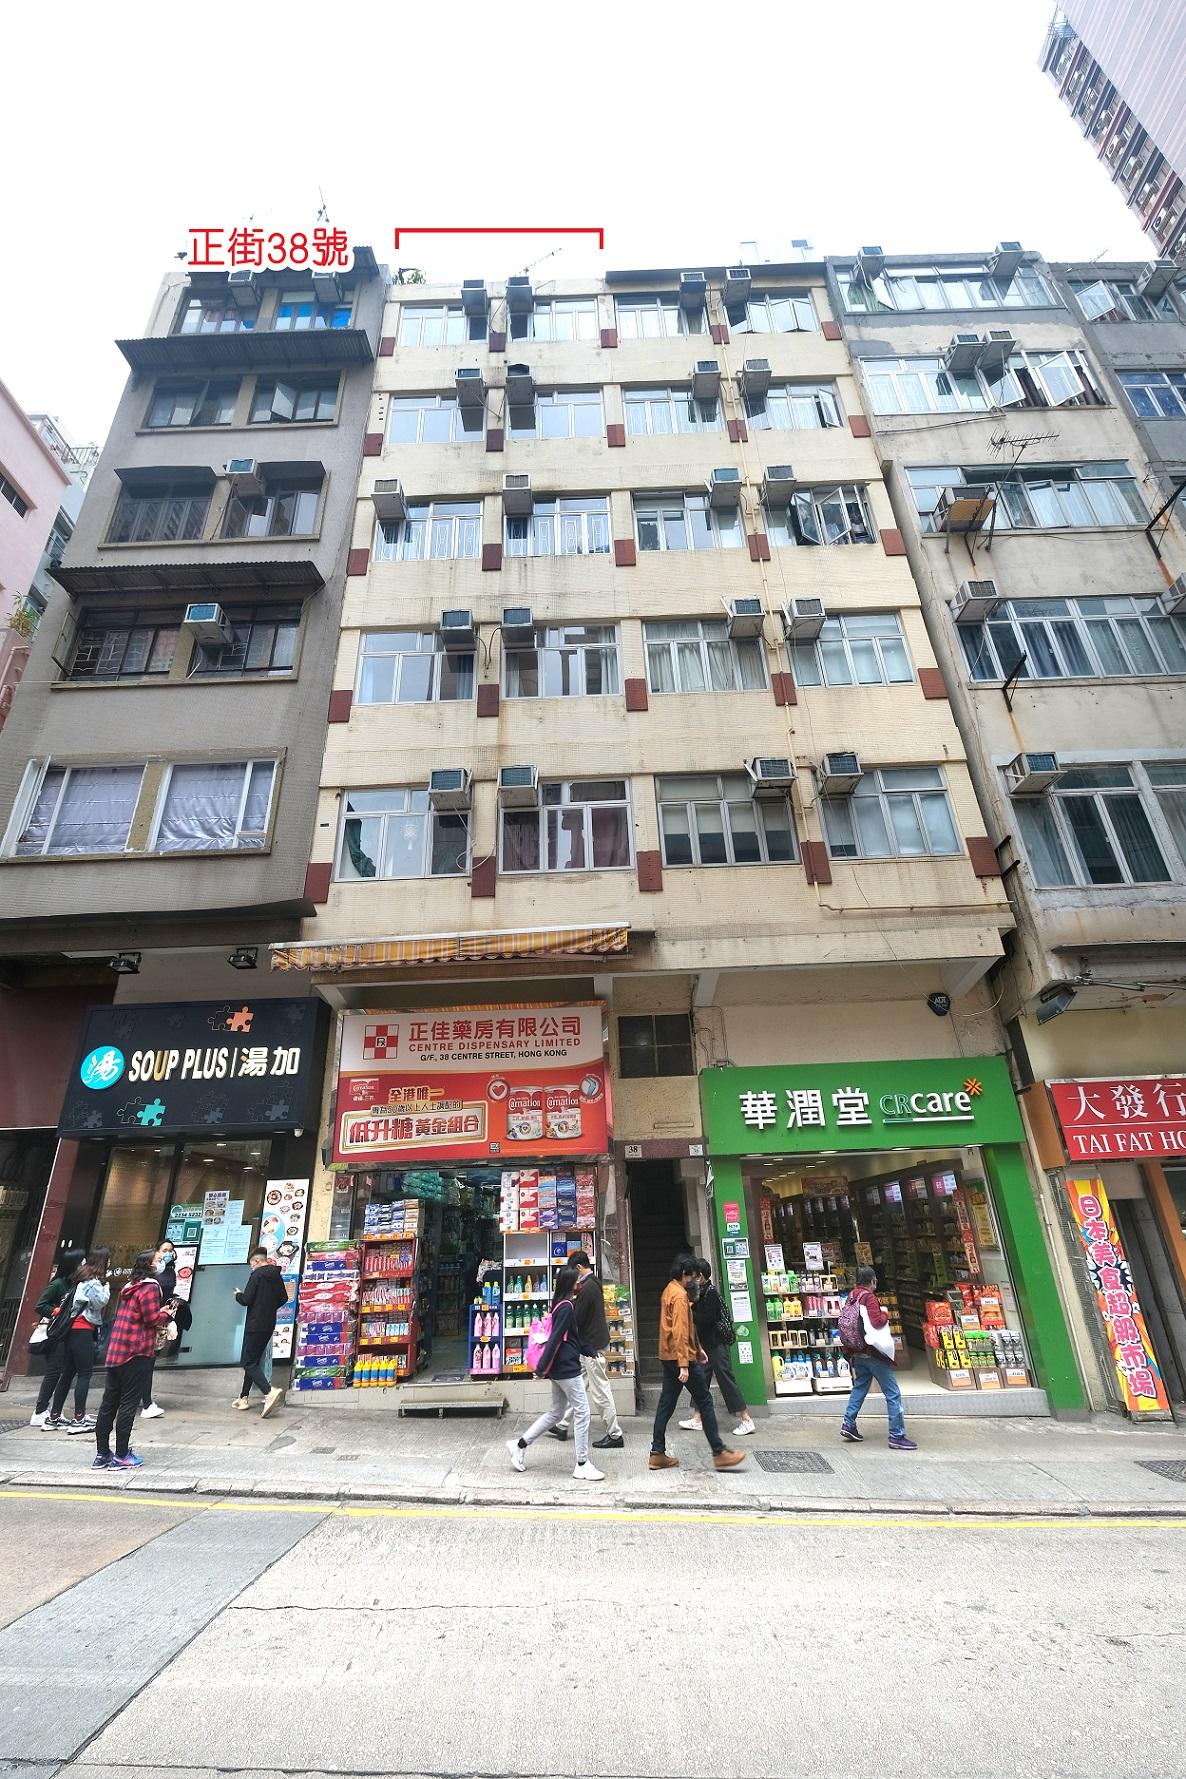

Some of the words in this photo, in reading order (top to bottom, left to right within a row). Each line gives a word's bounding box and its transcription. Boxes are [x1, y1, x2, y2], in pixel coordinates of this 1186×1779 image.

[408, 1015, 582, 1042] 正佳藥房有限公司
[408, 1042, 454, 1052] CENTRE
[458, 1039, 530, 1051] DISPENSARY
[534, 1037, 581, 1048] LIMITED
[439, 1053, 450, 1061] 38
[451, 1051, 483, 1061] CENTRE
[484, 1051, 516, 1061] STREET,
[518, 1050, 542, 1059] HONG
[543, 1049, 567, 1058] KONG
[128, 1049, 180, 1082] SOUP
[181, 1047, 228, 1080] PLUS
[238, 1046, 301, 1077] 湯加
[390, 1086, 443, 1101] 全港唯一
[879, 1090, 972, 1117] CRcare
[1067, 1083, 1186, 1120] 大發行
[738, 1086, 873, 1130] 華潤堂
[349, 1117, 413, 1144] 低升糖
[415, 1115, 480, 1137] 黃金組合
[1073, 1134, 1112, 1154] TAI
[1113, 1132, 1154, 1152] FAT
[628, 1145, 639, 1154] 38
[1078, 1194, 1157, 1398] 日本美食超級市場
